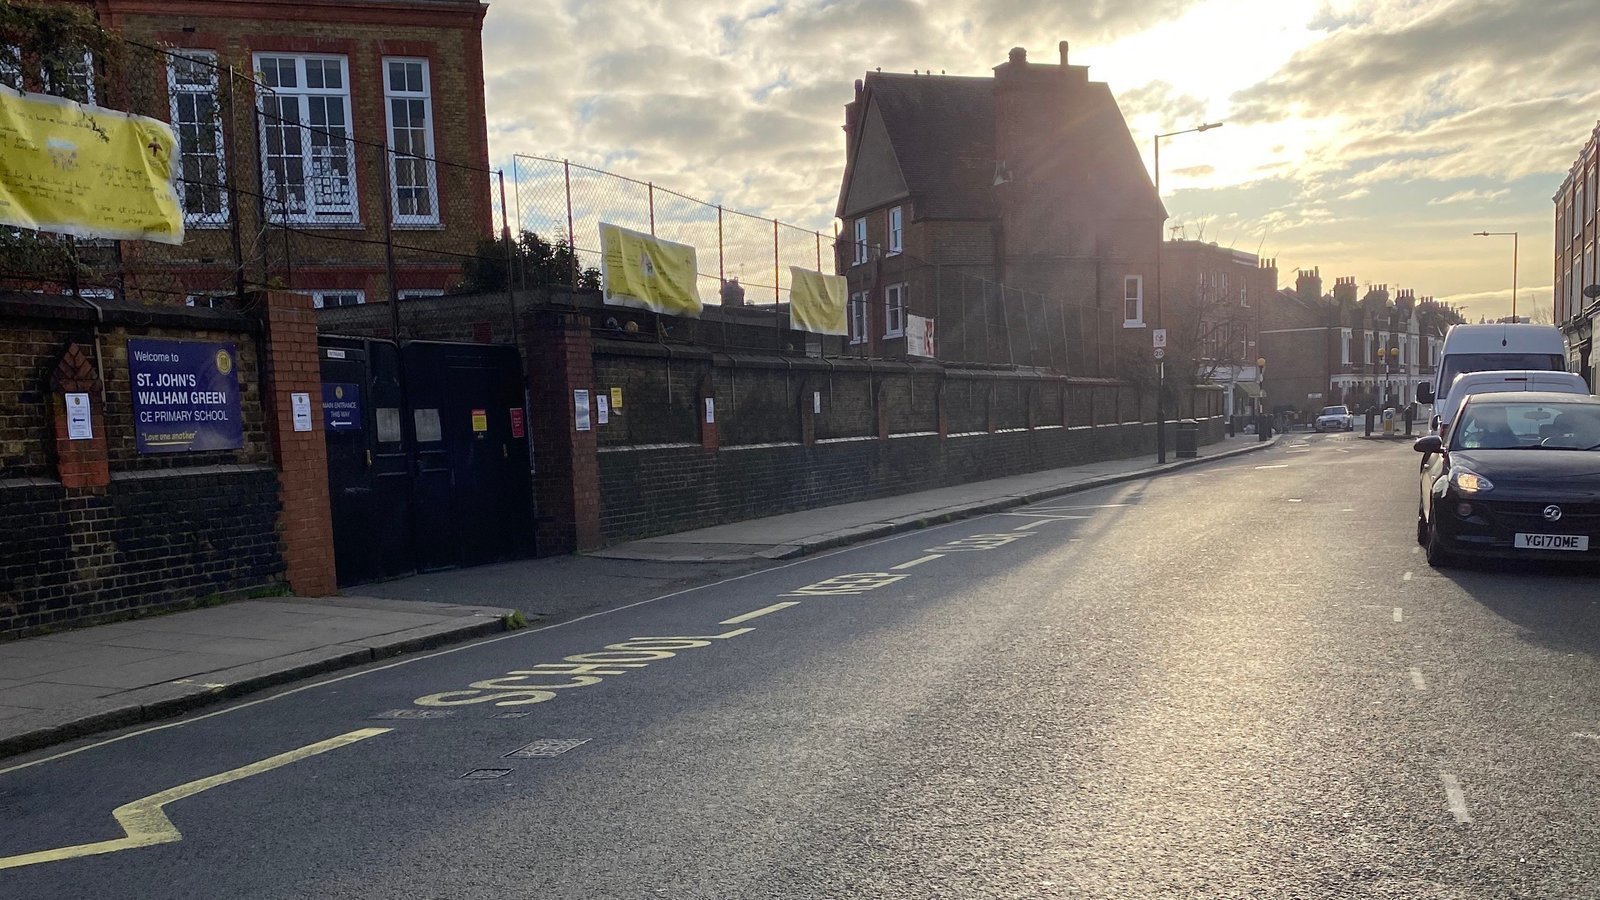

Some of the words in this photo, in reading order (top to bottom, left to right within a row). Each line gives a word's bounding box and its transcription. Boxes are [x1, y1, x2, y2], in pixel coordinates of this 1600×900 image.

[134, 351, 169, 362] Welcome
[171, 353, 179, 362] to
[136, 373, 153, 387] ST.
[156, 373, 197, 387] JOHN'S
[138, 391, 188, 405] WALHAM
[190, 391, 226, 404] GREEN
[334, 401, 357, 409] ENTRANCE
[140, 411, 153, 422] CE
[154, 411, 192, 422] PRIMARY
[194, 410, 228, 421] SCHOOL
[330, 410, 340, 418] THIS
[159, 433, 171, 441] one
[776, 572, 912, 597] KEEP
[413, 627, 756, 707] SCHOOL
